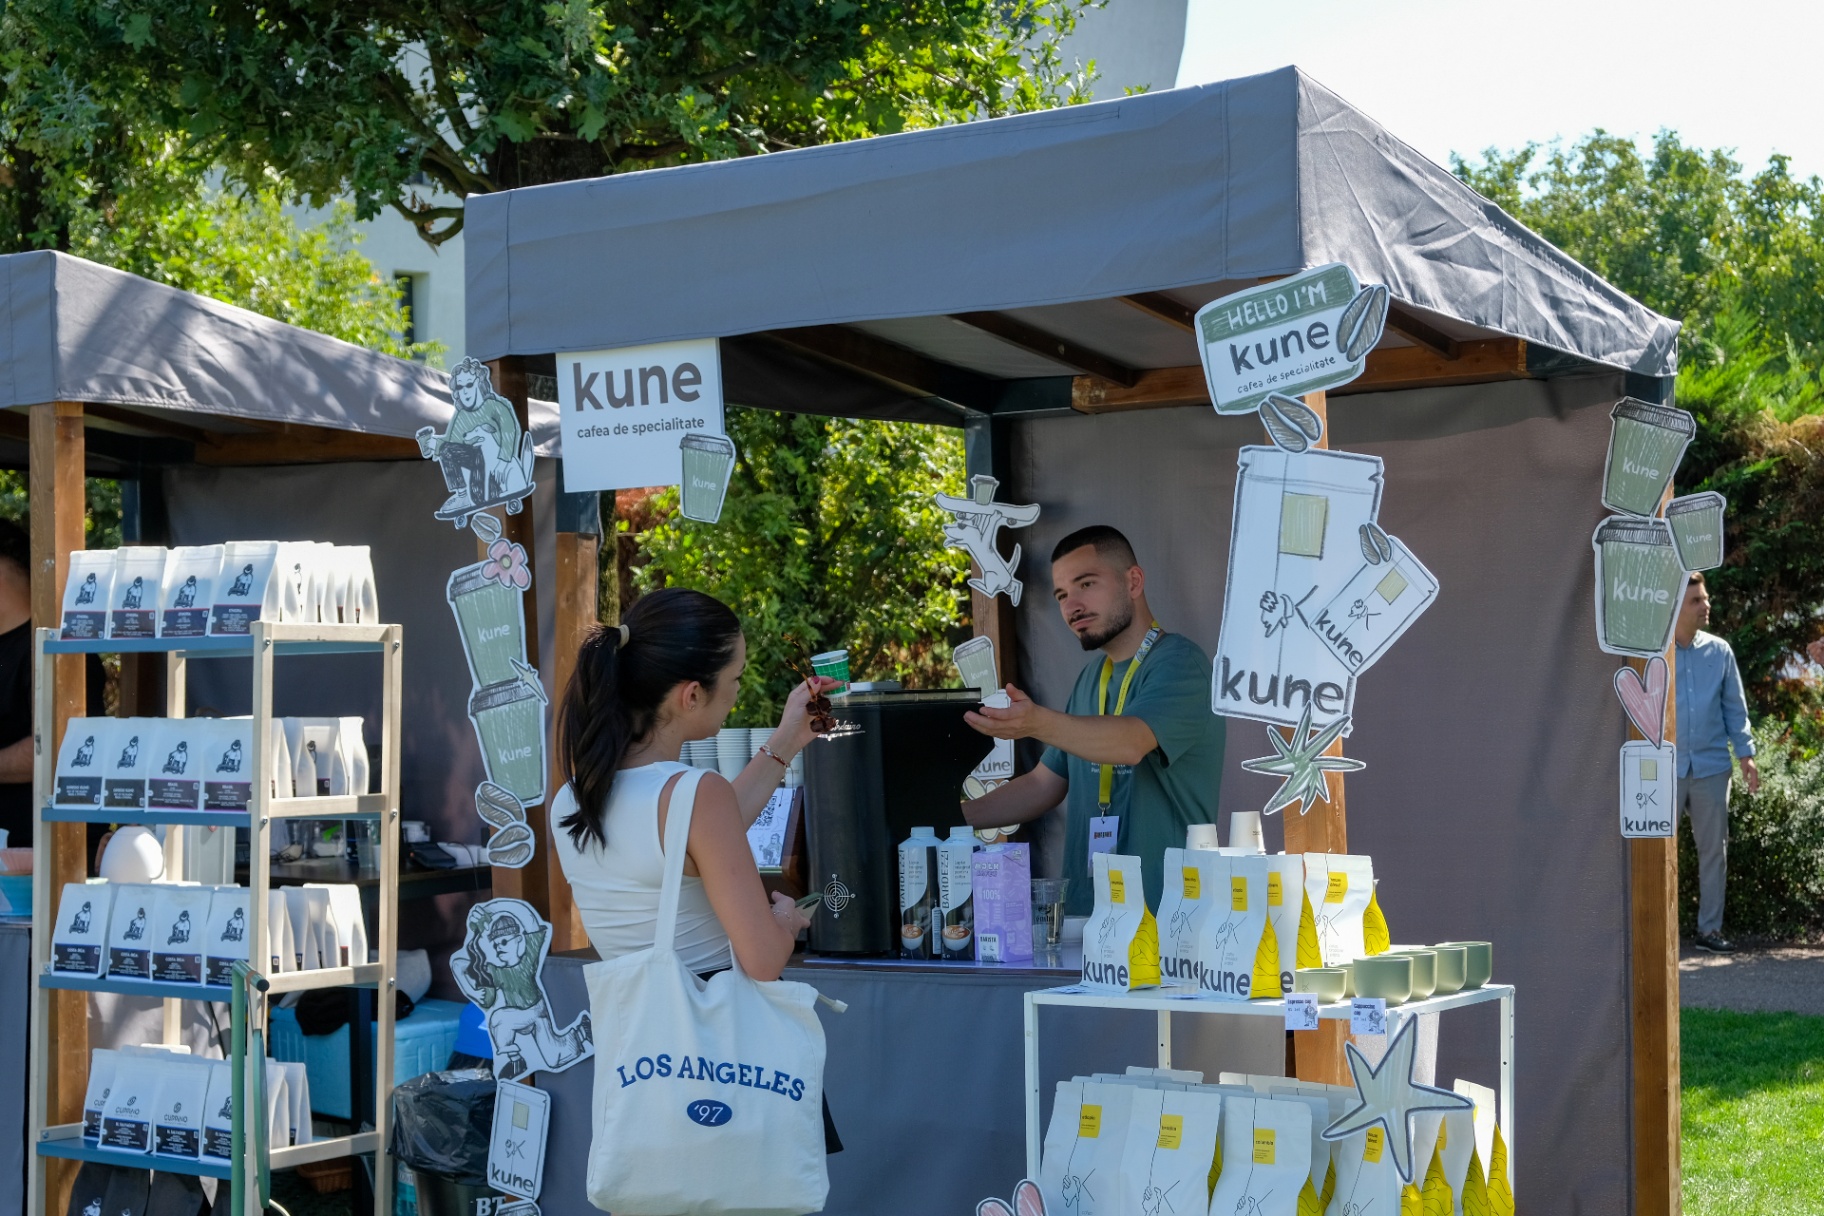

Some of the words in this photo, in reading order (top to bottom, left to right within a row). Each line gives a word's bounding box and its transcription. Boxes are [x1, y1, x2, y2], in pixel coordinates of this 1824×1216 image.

[1227, 293, 1289, 330] HELLO
[1294, 281, 1327, 309] I'M
[1230, 321, 1330, 376] kune
[572, 361, 702, 412] kune
[1237, 374, 1264, 394] cafea
[1267, 373, 1278, 384] de
[1280, 355, 1336, 380] specialitate
[577, 422, 610, 439] cafea
[613, 422, 629, 436] de
[631, 417, 705, 437] specialitate
[1622, 457, 1660, 481] kune
[692, 475, 717, 491] kune
[1685, 530, 1713, 546] kune
[1612, 580, 1670, 605] kune
[478, 624, 511, 643] kune
[1315, 610, 1364, 668] kune
[970, 669, 989, 681] kune
[1220, 656, 1344, 714] kune
[498, 745, 532, 765] kune
[1623, 816, 1672, 833] kune
[941, 850, 950, 909] BARDEZZI
[982, 889, 1001, 901] 100%
[1084, 954, 1128, 987] kune
[1199, 961, 1250, 996] kune
[617, 1053, 672, 1089] LOS
[676, 1056, 806, 1102] ANGELES
[693, 1104, 724, 1124] '97
[491, 1163, 534, 1193] kune
